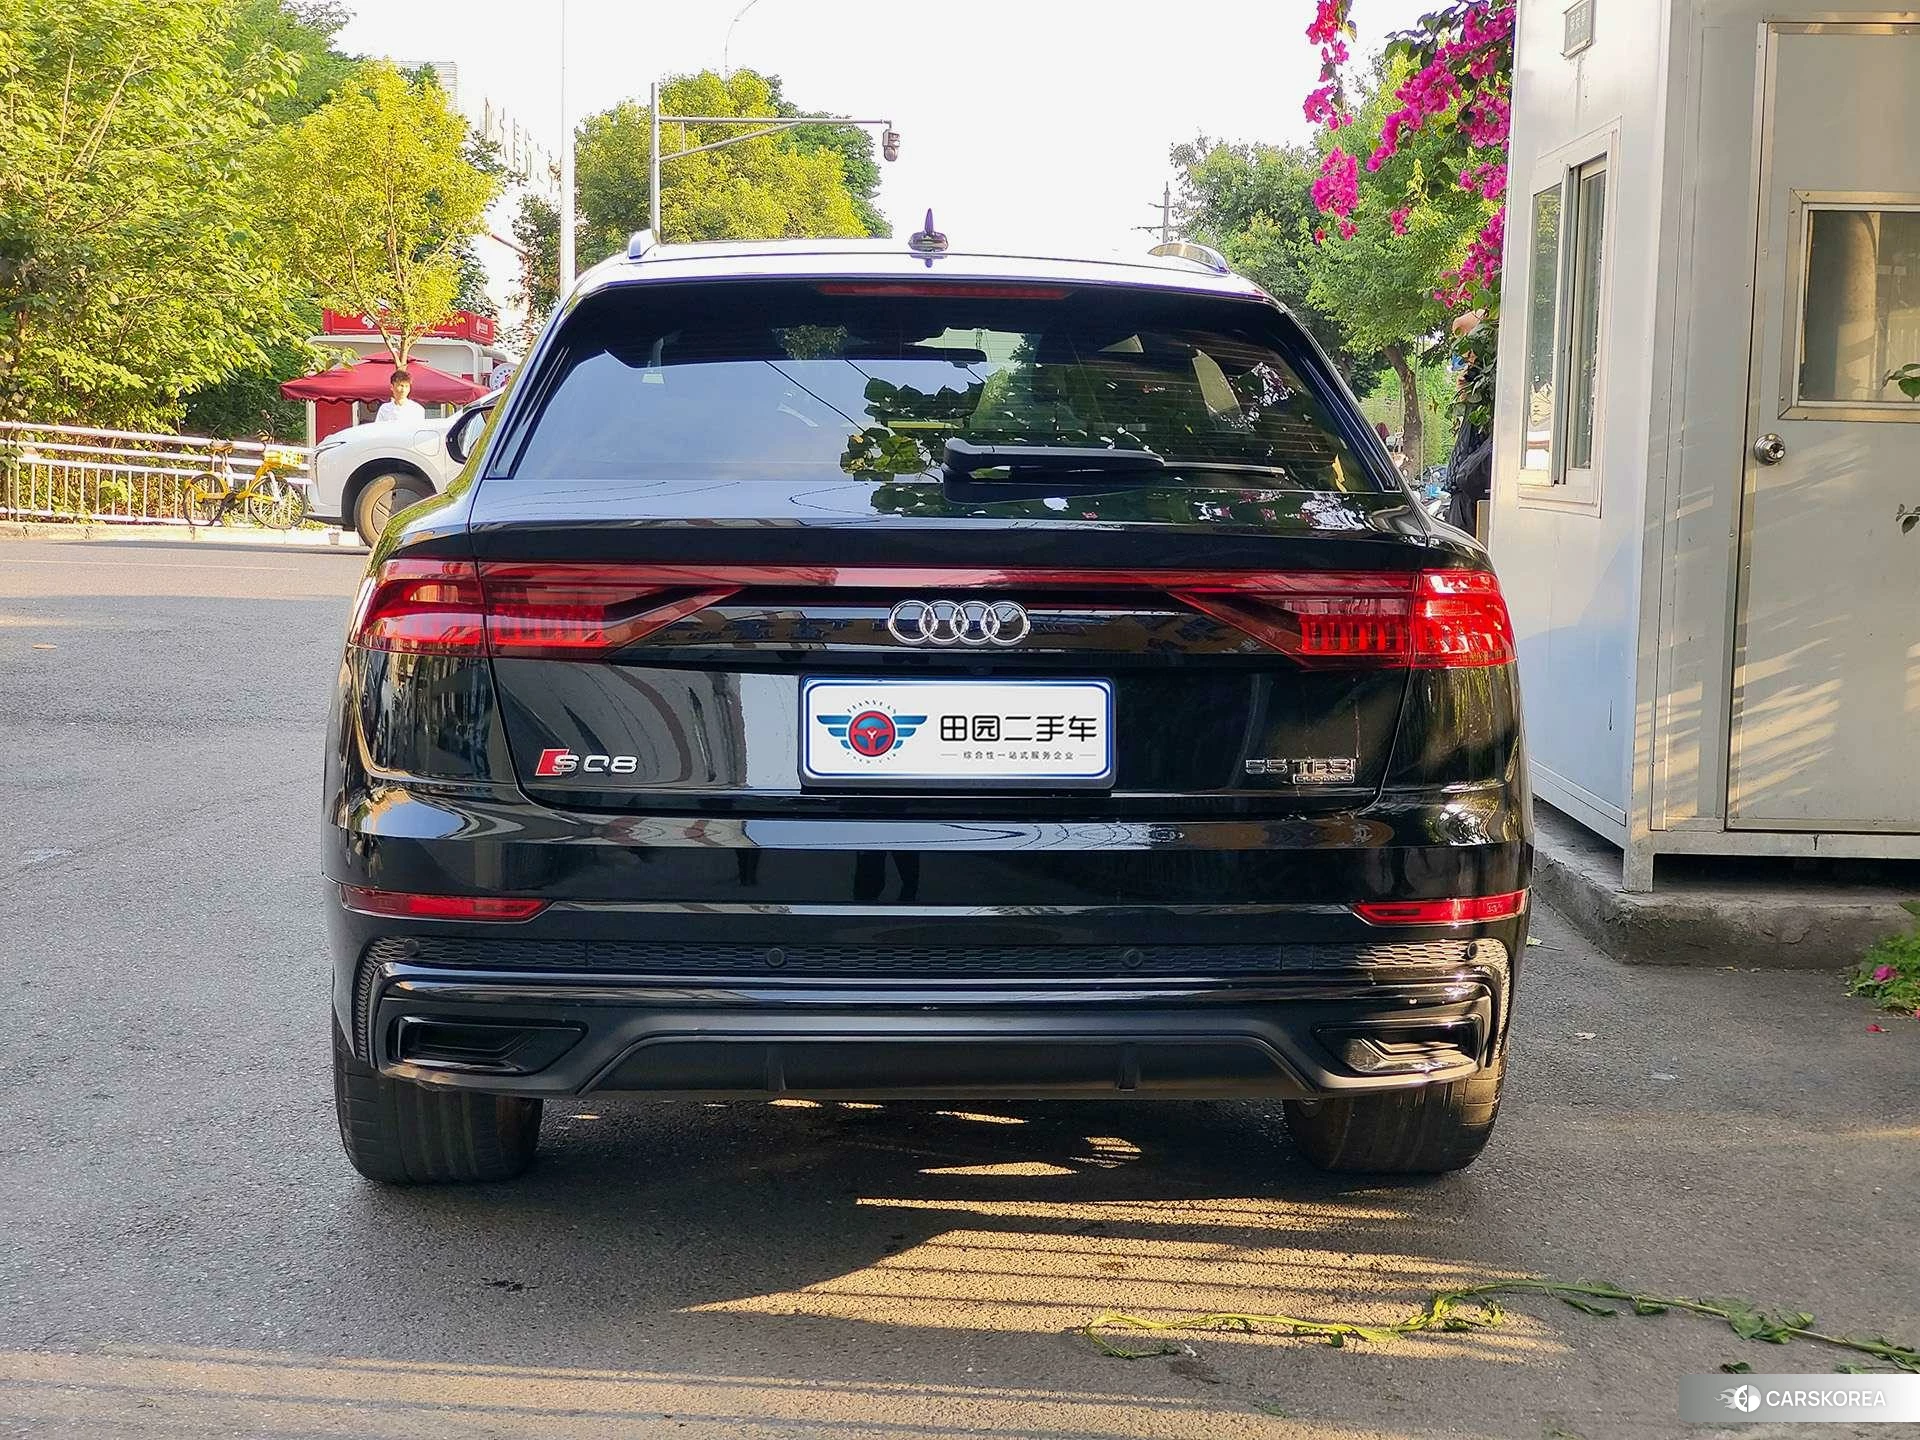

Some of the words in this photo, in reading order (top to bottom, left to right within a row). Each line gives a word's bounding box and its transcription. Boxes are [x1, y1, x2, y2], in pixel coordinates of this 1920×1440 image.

[940, 715, 1098, 742] 田园二手车
